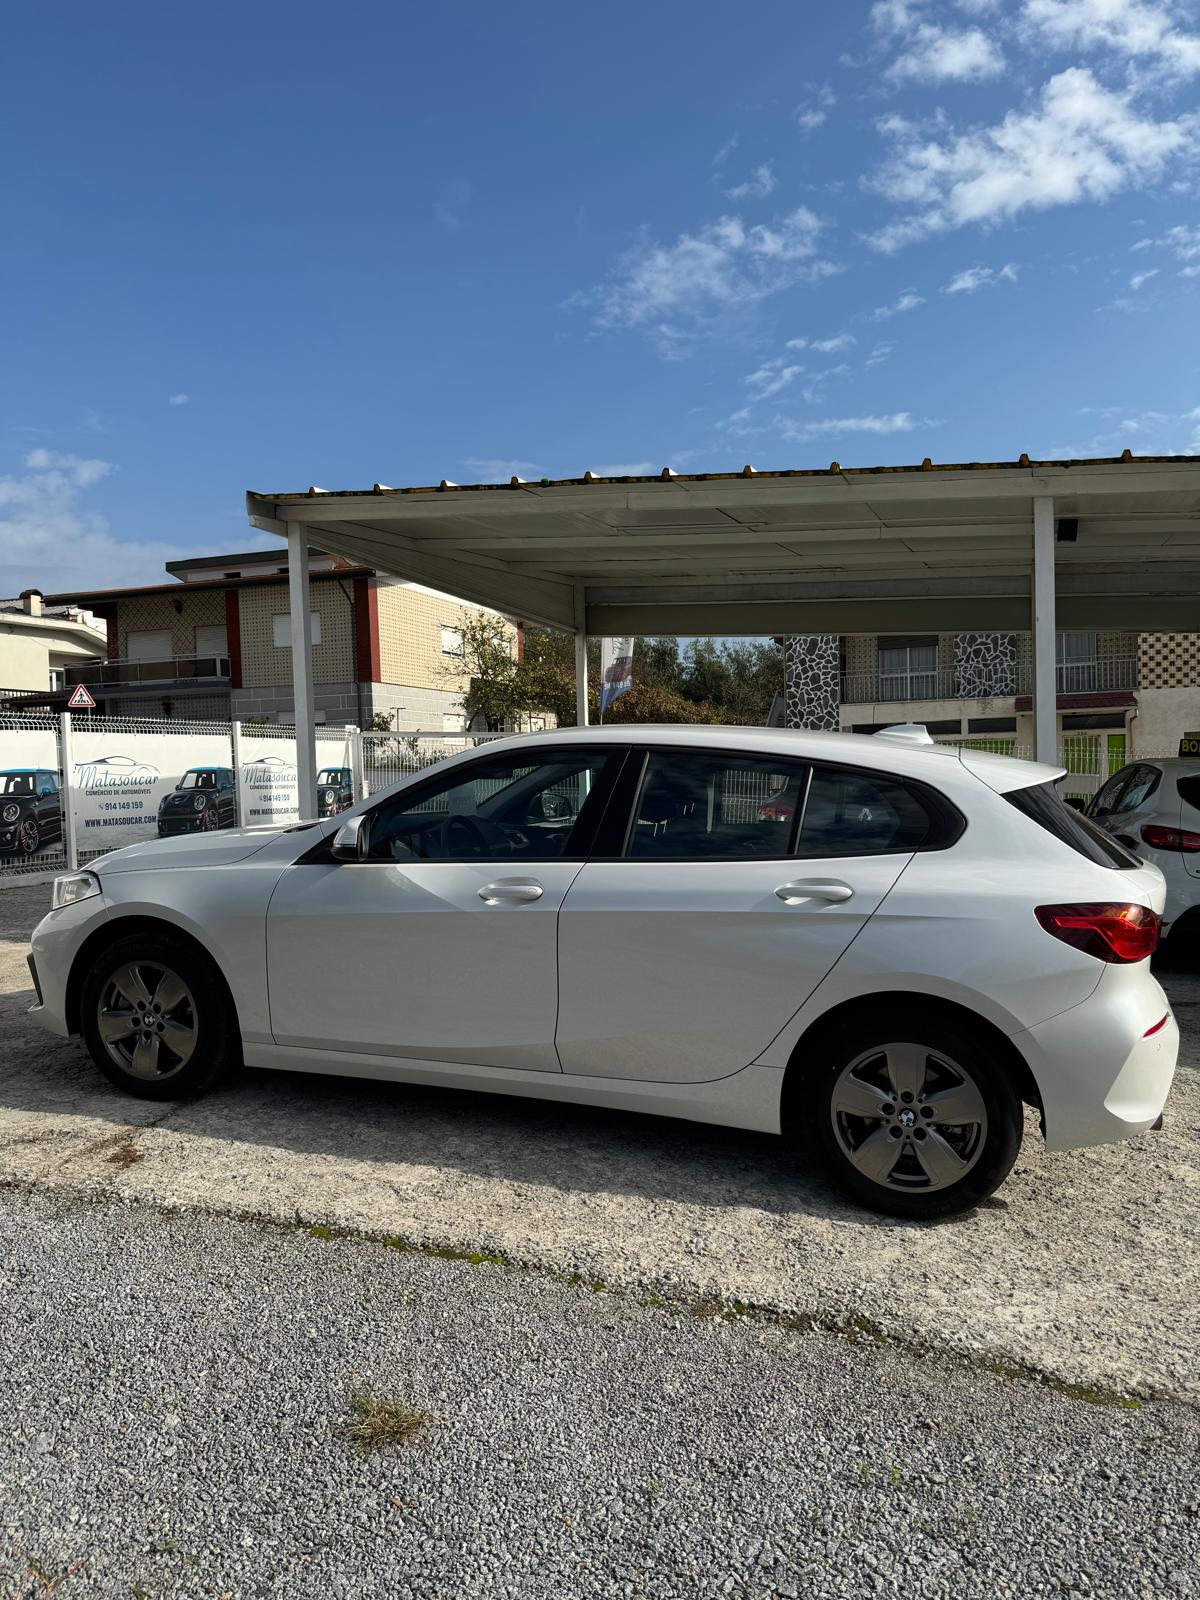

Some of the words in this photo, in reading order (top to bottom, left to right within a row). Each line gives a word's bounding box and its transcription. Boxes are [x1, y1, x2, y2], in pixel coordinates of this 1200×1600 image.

[1182, 739, 1200, 752] BO
[78, 765, 158, 789] Matasoucar
[242, 766, 297, 784] Matasouca
[105, 803, 117, 811] 914
[118, 802, 130, 810] 149
[132, 801, 143, 809] 159
[85, 816, 157, 828] WWW.MATASOUCAR.COM
